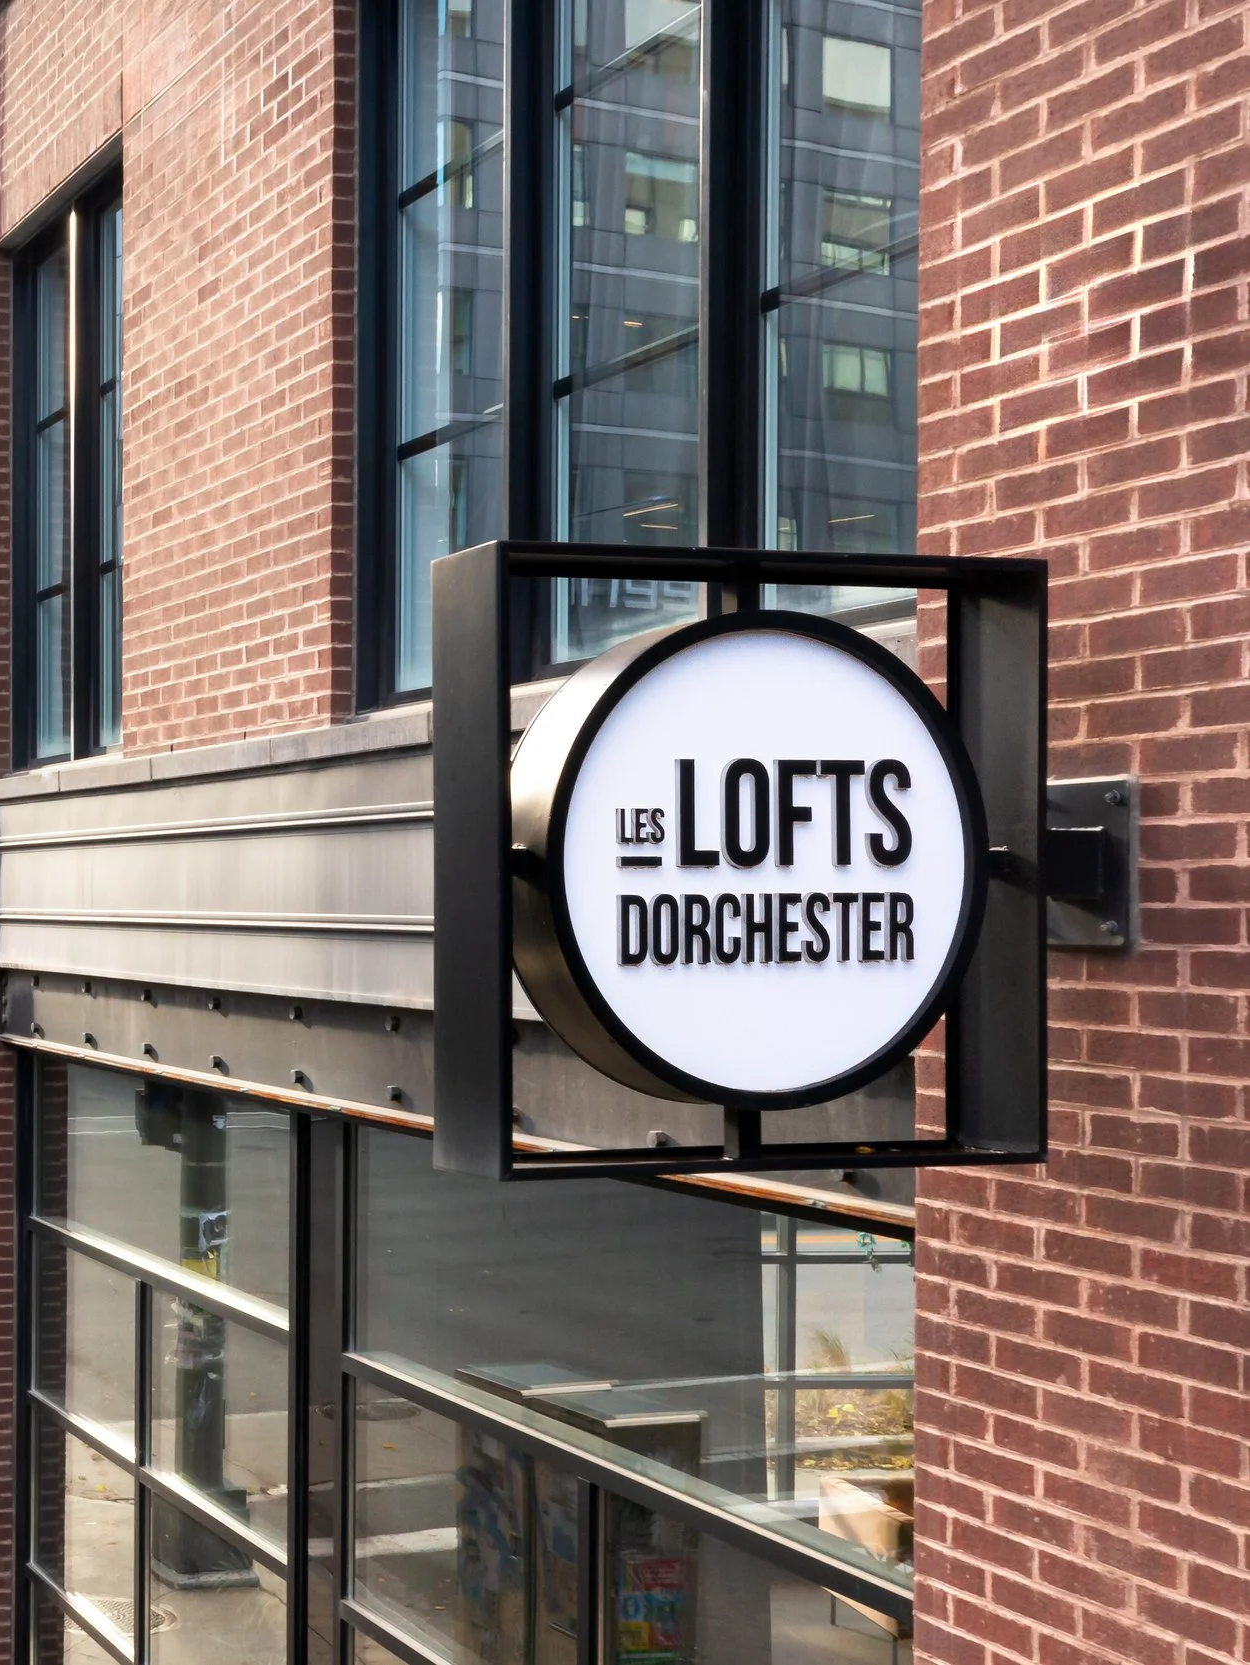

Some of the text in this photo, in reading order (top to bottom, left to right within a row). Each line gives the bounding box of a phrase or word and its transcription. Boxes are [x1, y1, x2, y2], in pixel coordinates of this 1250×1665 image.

[616, 758, 912, 868] LES LOFTS
[616, 892, 914, 966] DORCHESTER
